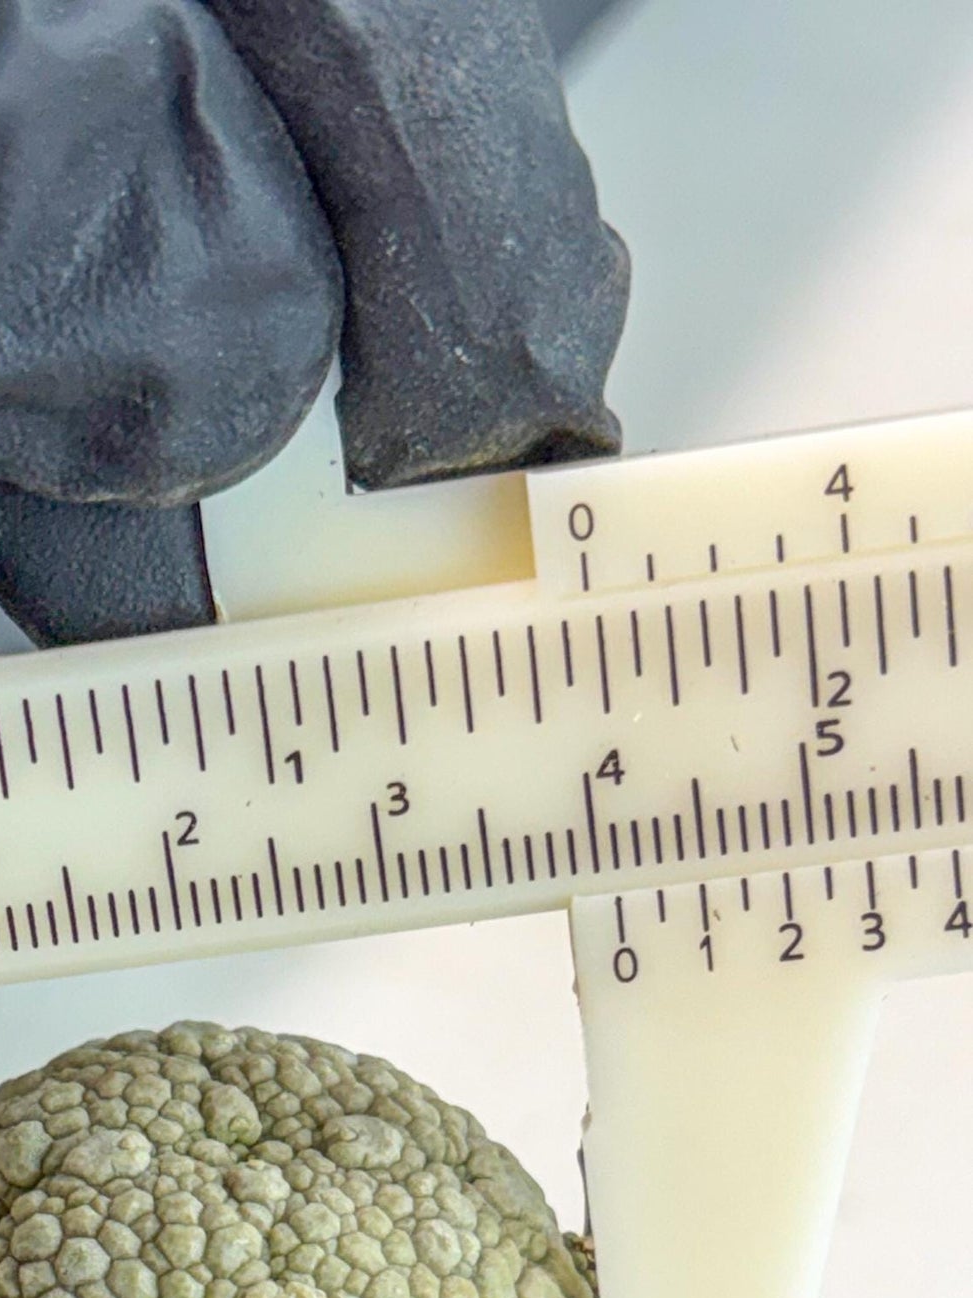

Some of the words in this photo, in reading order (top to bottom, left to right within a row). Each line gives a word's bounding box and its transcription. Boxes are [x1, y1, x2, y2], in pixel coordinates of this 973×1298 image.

[568, 503, 594, 541] 0
[824, 464, 854, 502] 4
[284, 751, 304, 784] 1
[827, 671, 852, 708] 2
[175, 811, 199, 846] 2
[386, 782, 410, 816] 3
[596, 750, 625, 785] 4
[816, 719, 844, 756] 5
[613, 947, 638, 983] 0
[700, 936, 714, 971] 1
[779, 924, 804, 961] 2
[861, 913, 886, 951] 3
[945, 901, 973, 939] 4
